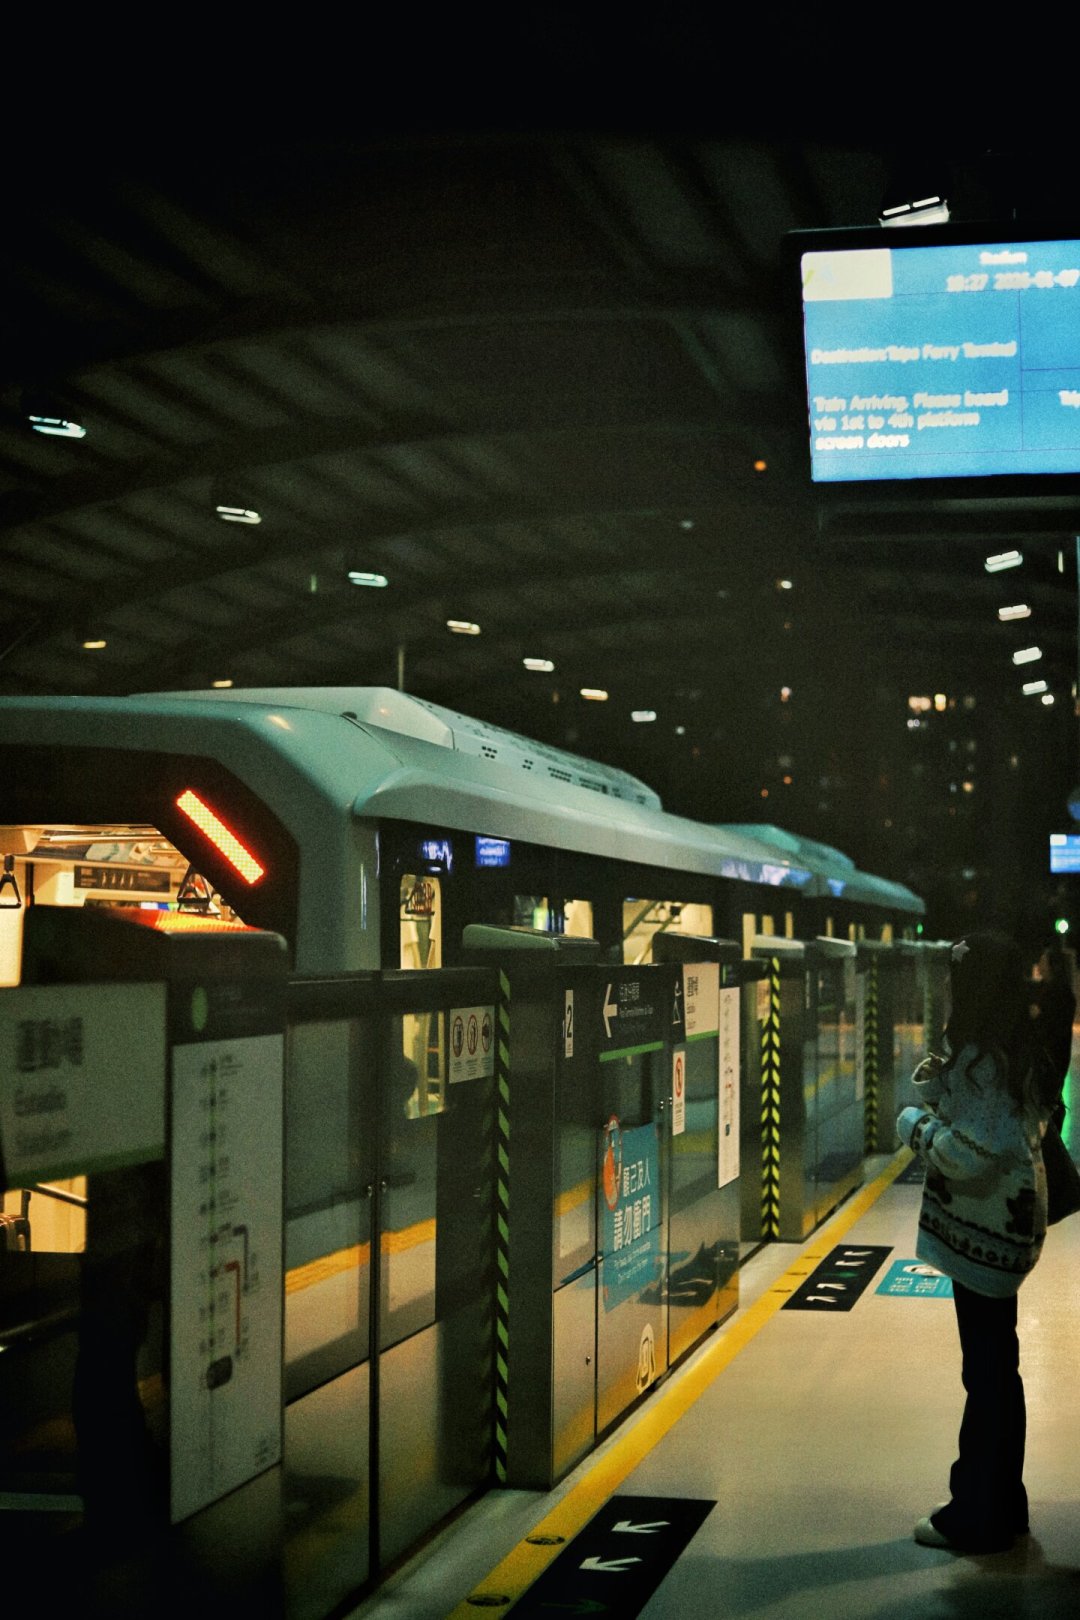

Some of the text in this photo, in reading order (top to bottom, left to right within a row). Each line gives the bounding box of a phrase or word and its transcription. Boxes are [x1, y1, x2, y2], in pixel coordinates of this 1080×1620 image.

[922, 343, 960, 361] Ferry
[813, 396, 847, 413] Train
[913, 392, 961, 408] Please
[814, 411, 980, 432] via 1st to 4th platform
[814, 432, 911, 450] screen doors
[566, 1004, 572, 1039] 2
